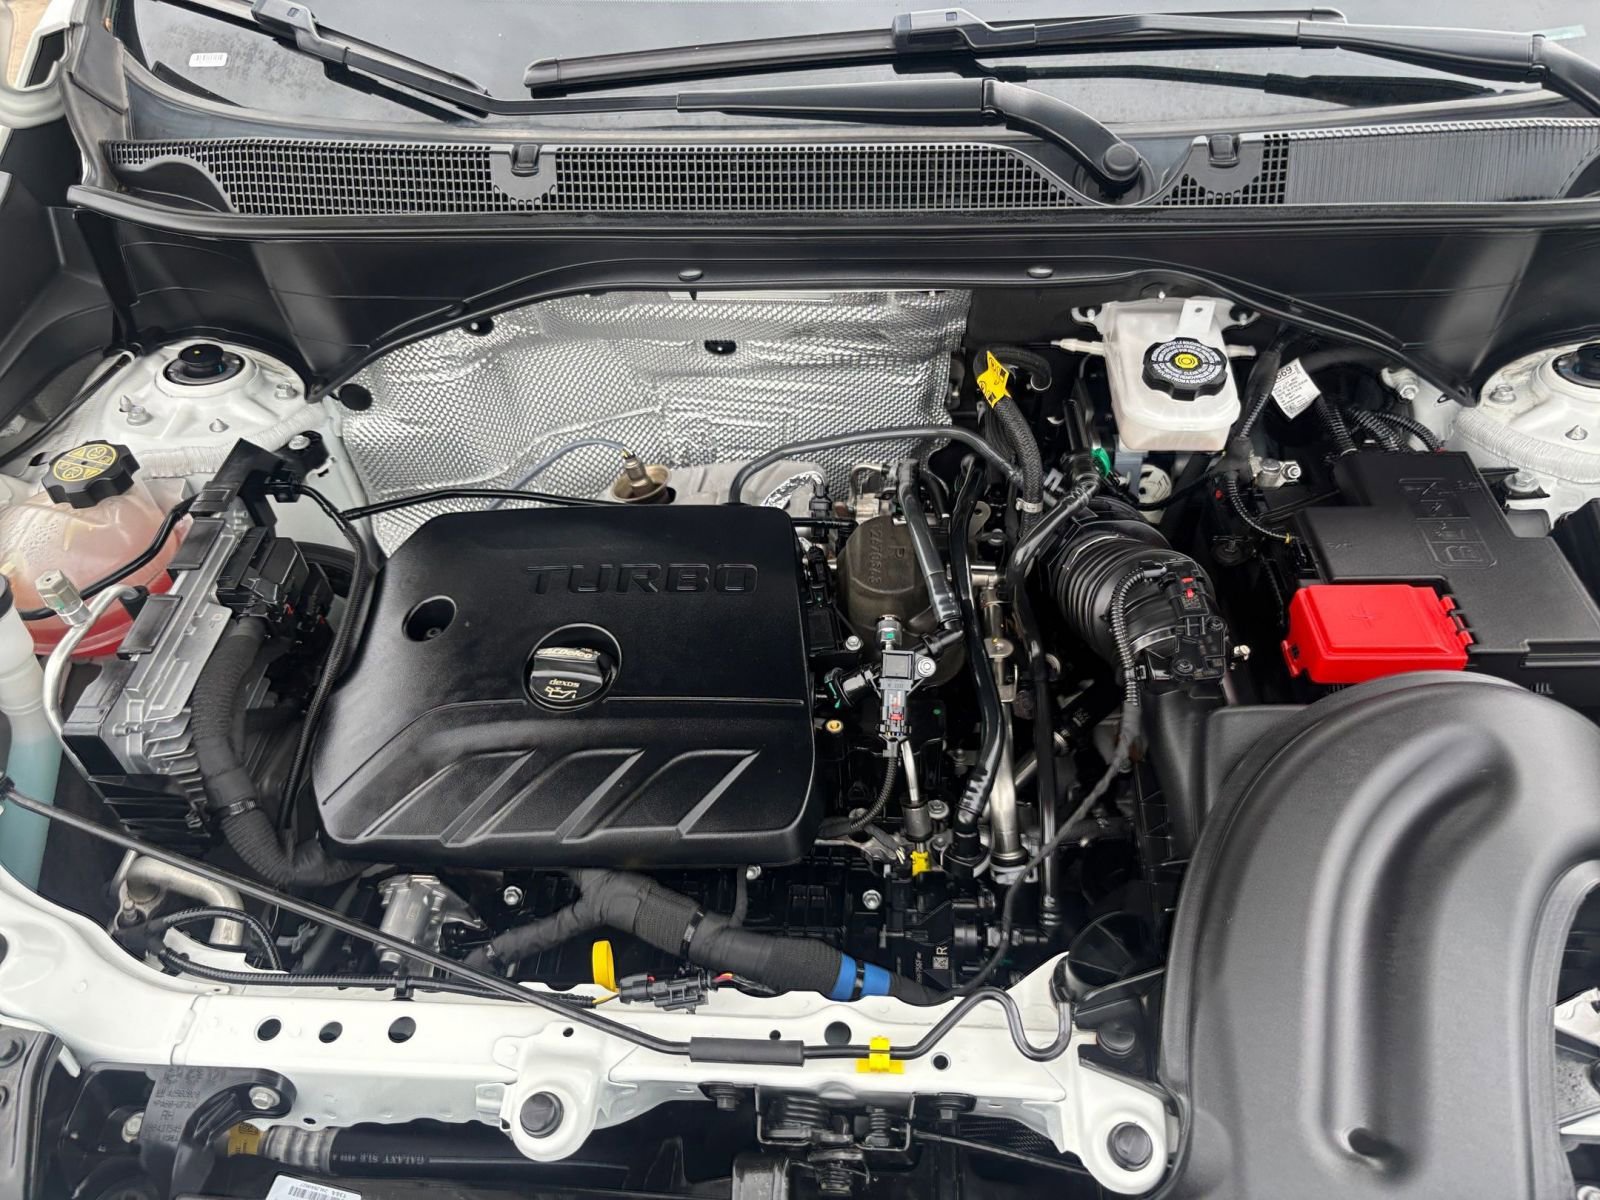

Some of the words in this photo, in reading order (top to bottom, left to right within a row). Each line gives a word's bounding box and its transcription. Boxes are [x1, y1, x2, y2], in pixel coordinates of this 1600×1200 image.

[527, 563, 758, 594] TURBO
[549, 679, 580, 688] dexos
[936, 946, 948, 955] R
